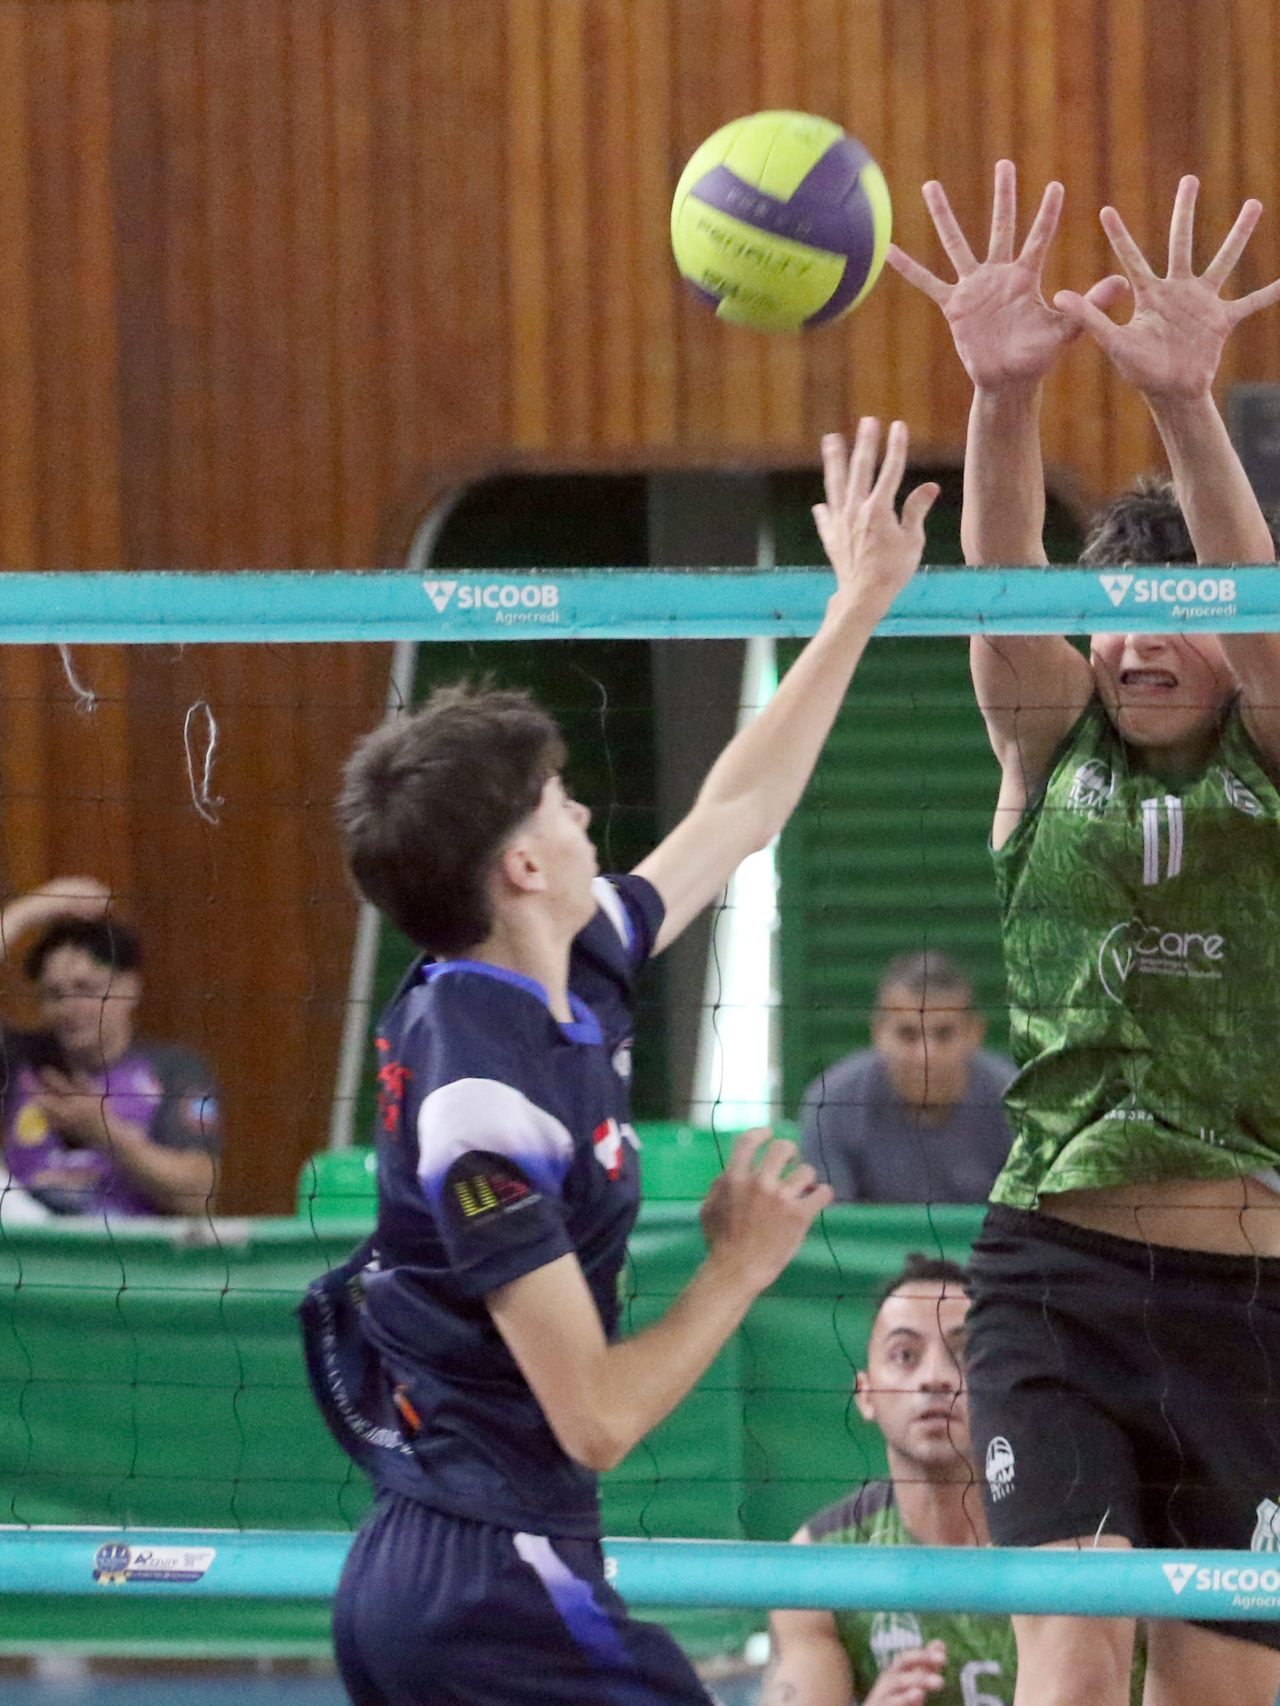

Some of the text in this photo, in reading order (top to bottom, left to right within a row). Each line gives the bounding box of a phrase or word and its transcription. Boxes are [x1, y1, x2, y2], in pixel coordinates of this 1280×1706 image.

[457, 584, 560, 608] SICOOB
[1134, 578, 1236, 603] SICOOB
[495, 610, 559, 625] Agrocredi
[1171, 604, 1237, 618] Agrocredi
[1141, 794, 1183, 885] 11
